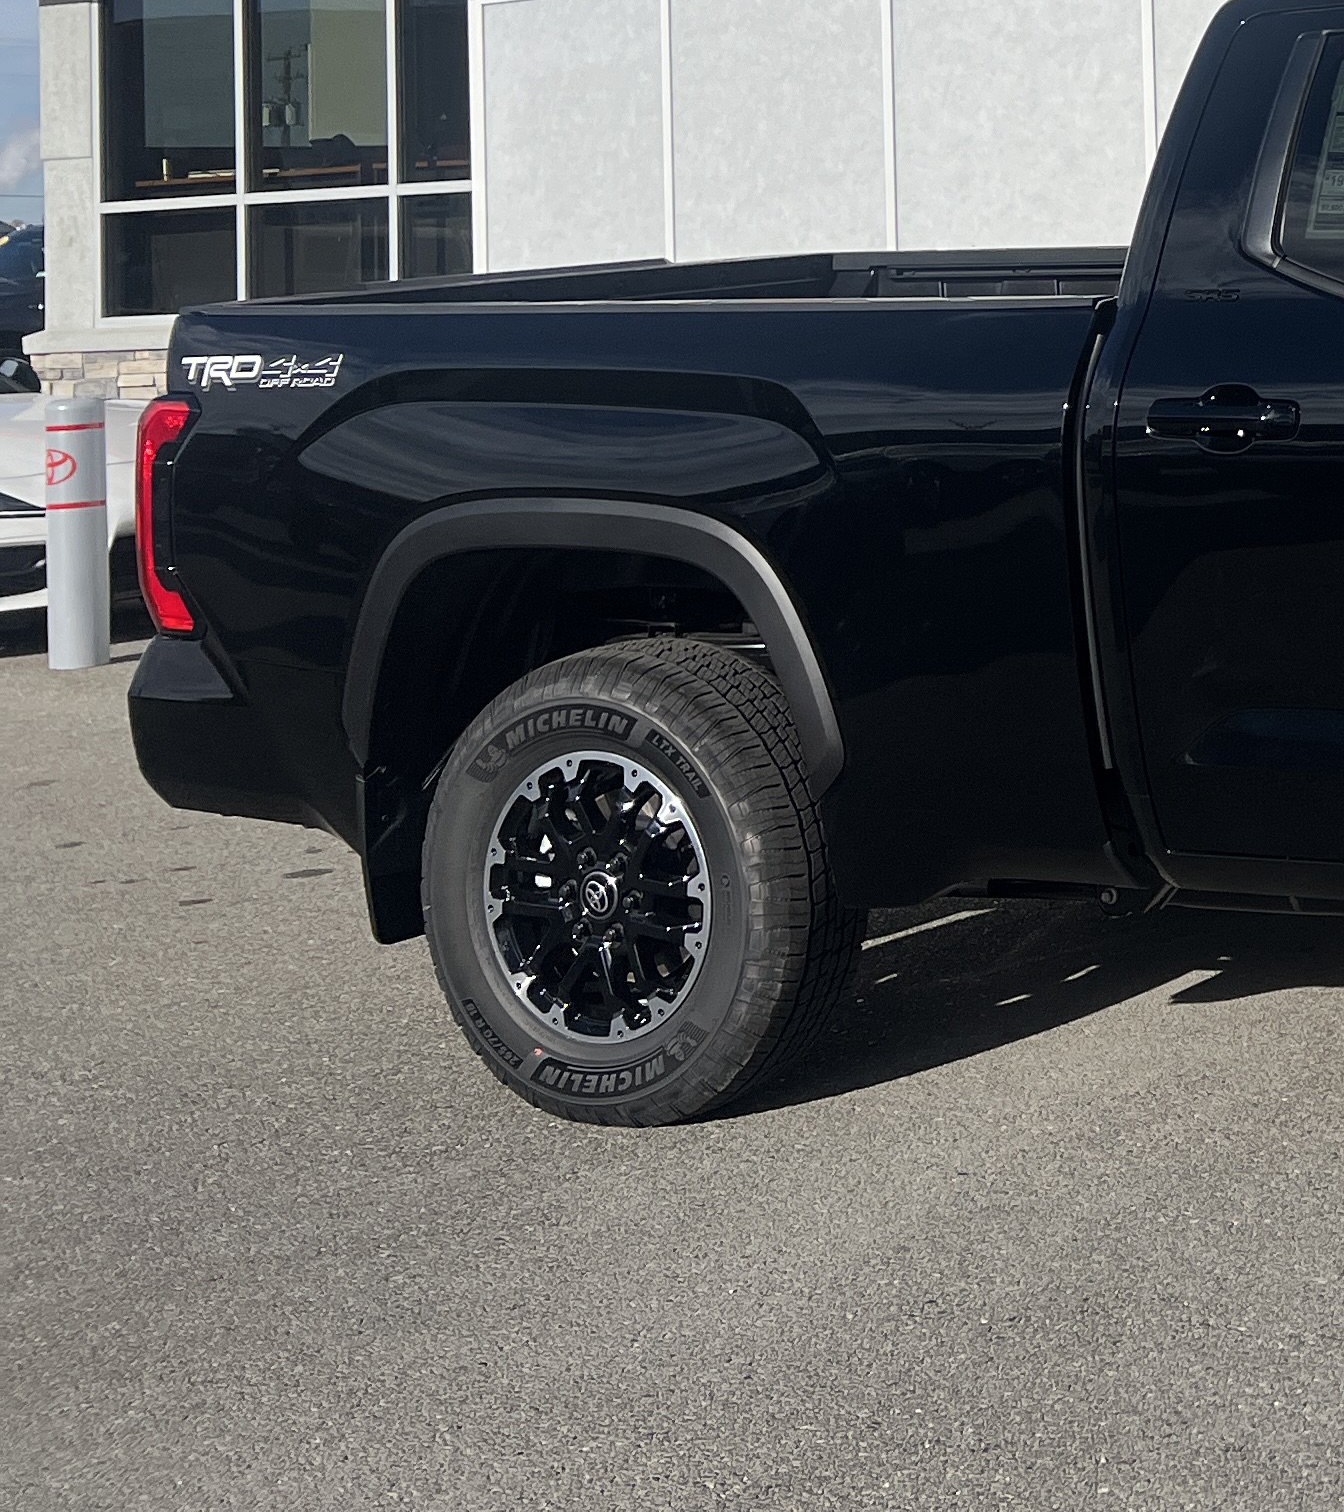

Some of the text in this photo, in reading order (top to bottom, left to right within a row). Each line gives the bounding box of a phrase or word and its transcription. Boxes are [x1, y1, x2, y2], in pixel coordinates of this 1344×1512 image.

[181, 354, 264, 390] TRD
[259, 377, 336, 388] OFF ROAD
[505, 707, 628, 750] MICHELIN
[651, 734, 678, 759] LTX
[538, 1049, 666, 1092] MICHELIN
